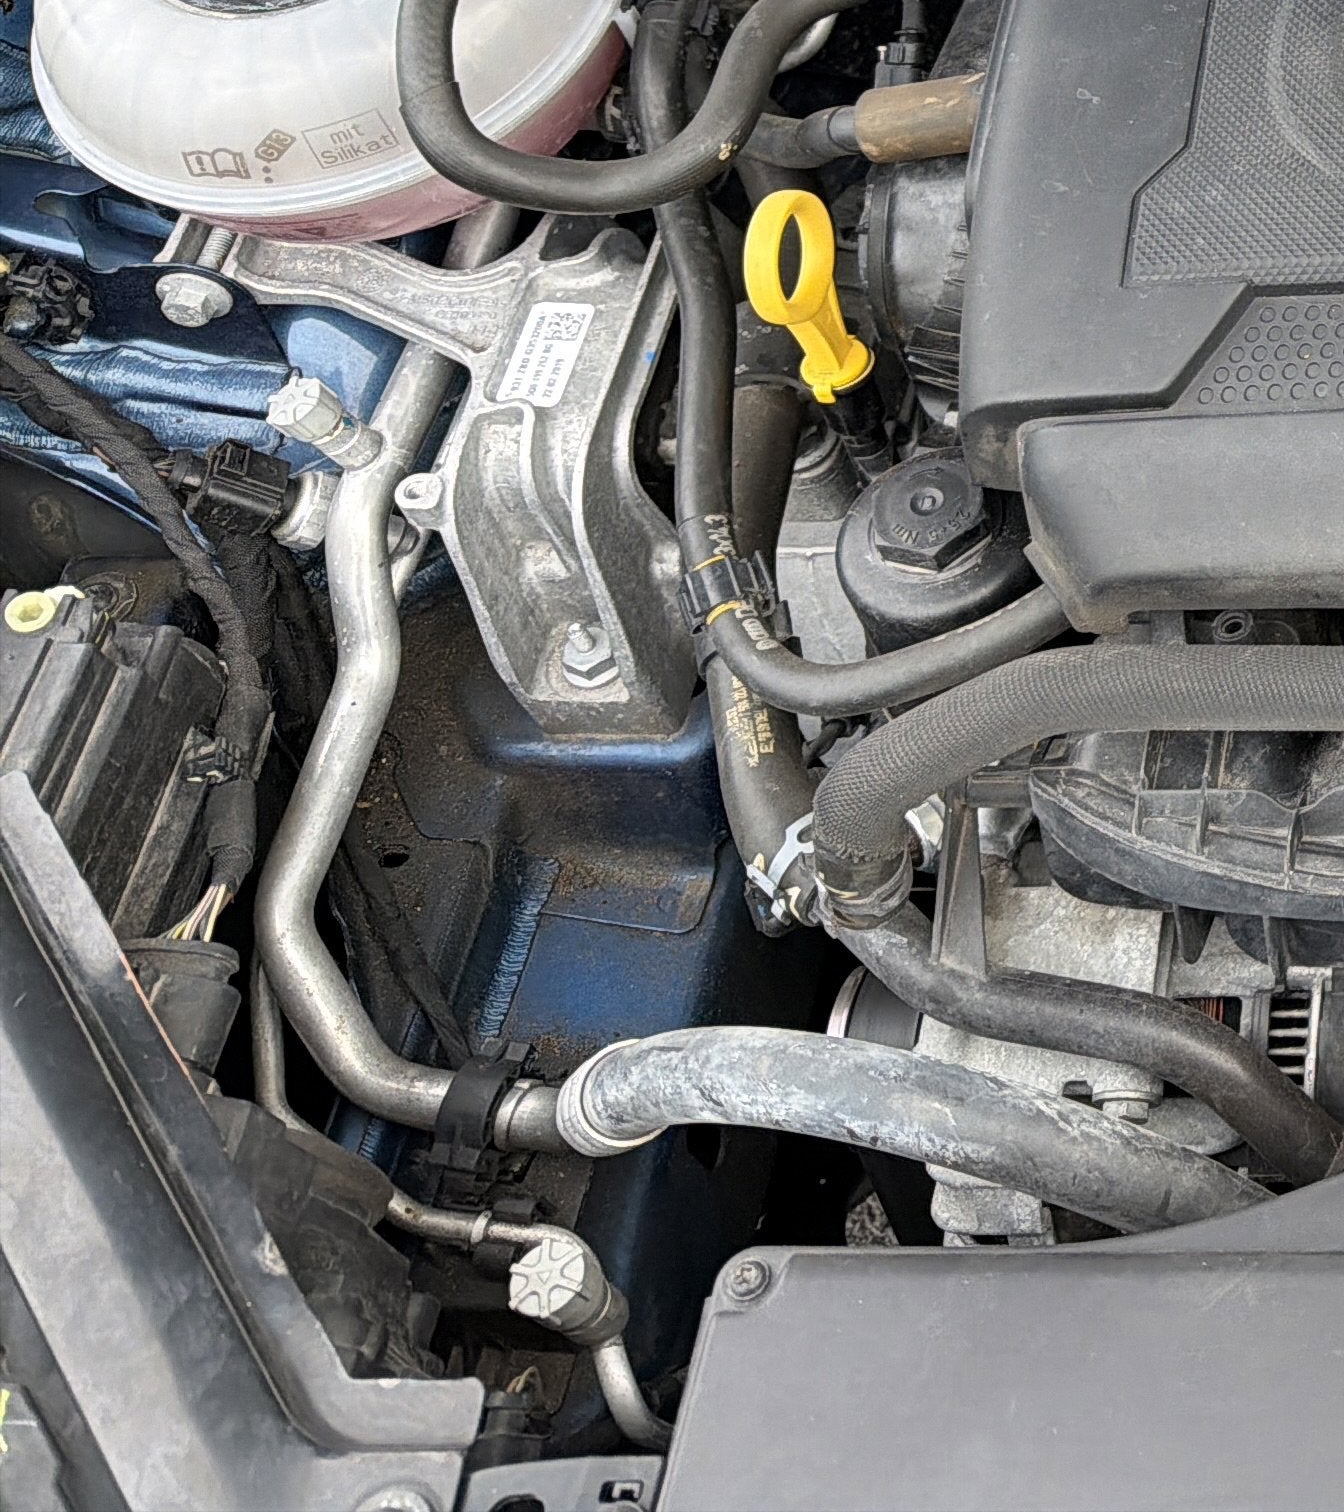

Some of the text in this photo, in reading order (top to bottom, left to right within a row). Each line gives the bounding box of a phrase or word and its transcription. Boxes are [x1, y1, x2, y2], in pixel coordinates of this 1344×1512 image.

[257, 131, 291, 161] G13
[329, 123, 363, 145] mit
[321, 134, 393, 165] Silikat
